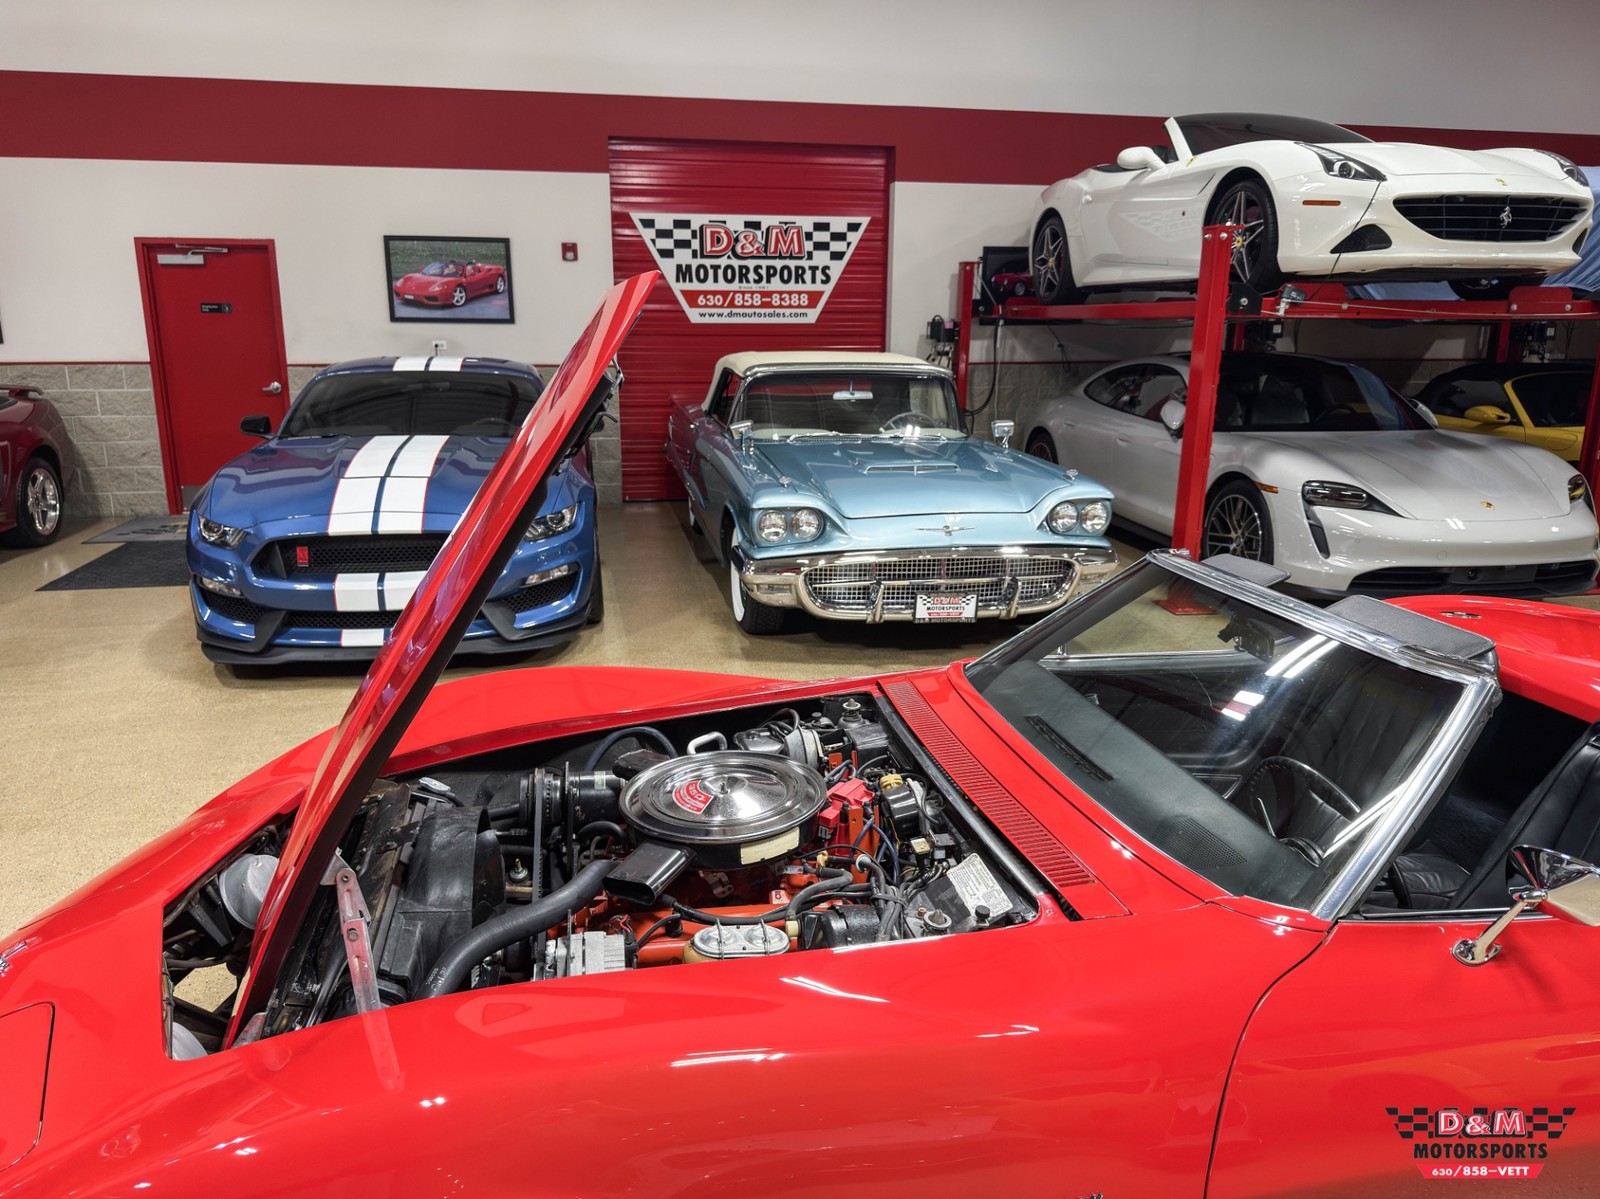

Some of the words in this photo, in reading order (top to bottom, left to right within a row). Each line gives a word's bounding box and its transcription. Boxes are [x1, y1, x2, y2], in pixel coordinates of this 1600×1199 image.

[700, 224, 805, 259] D&M
[675, 264, 832, 285] MOTORSPORTS
[697, 292, 809, 307] 630/858-8388
[698, 310, 808, 318] www.dmautosales.com
